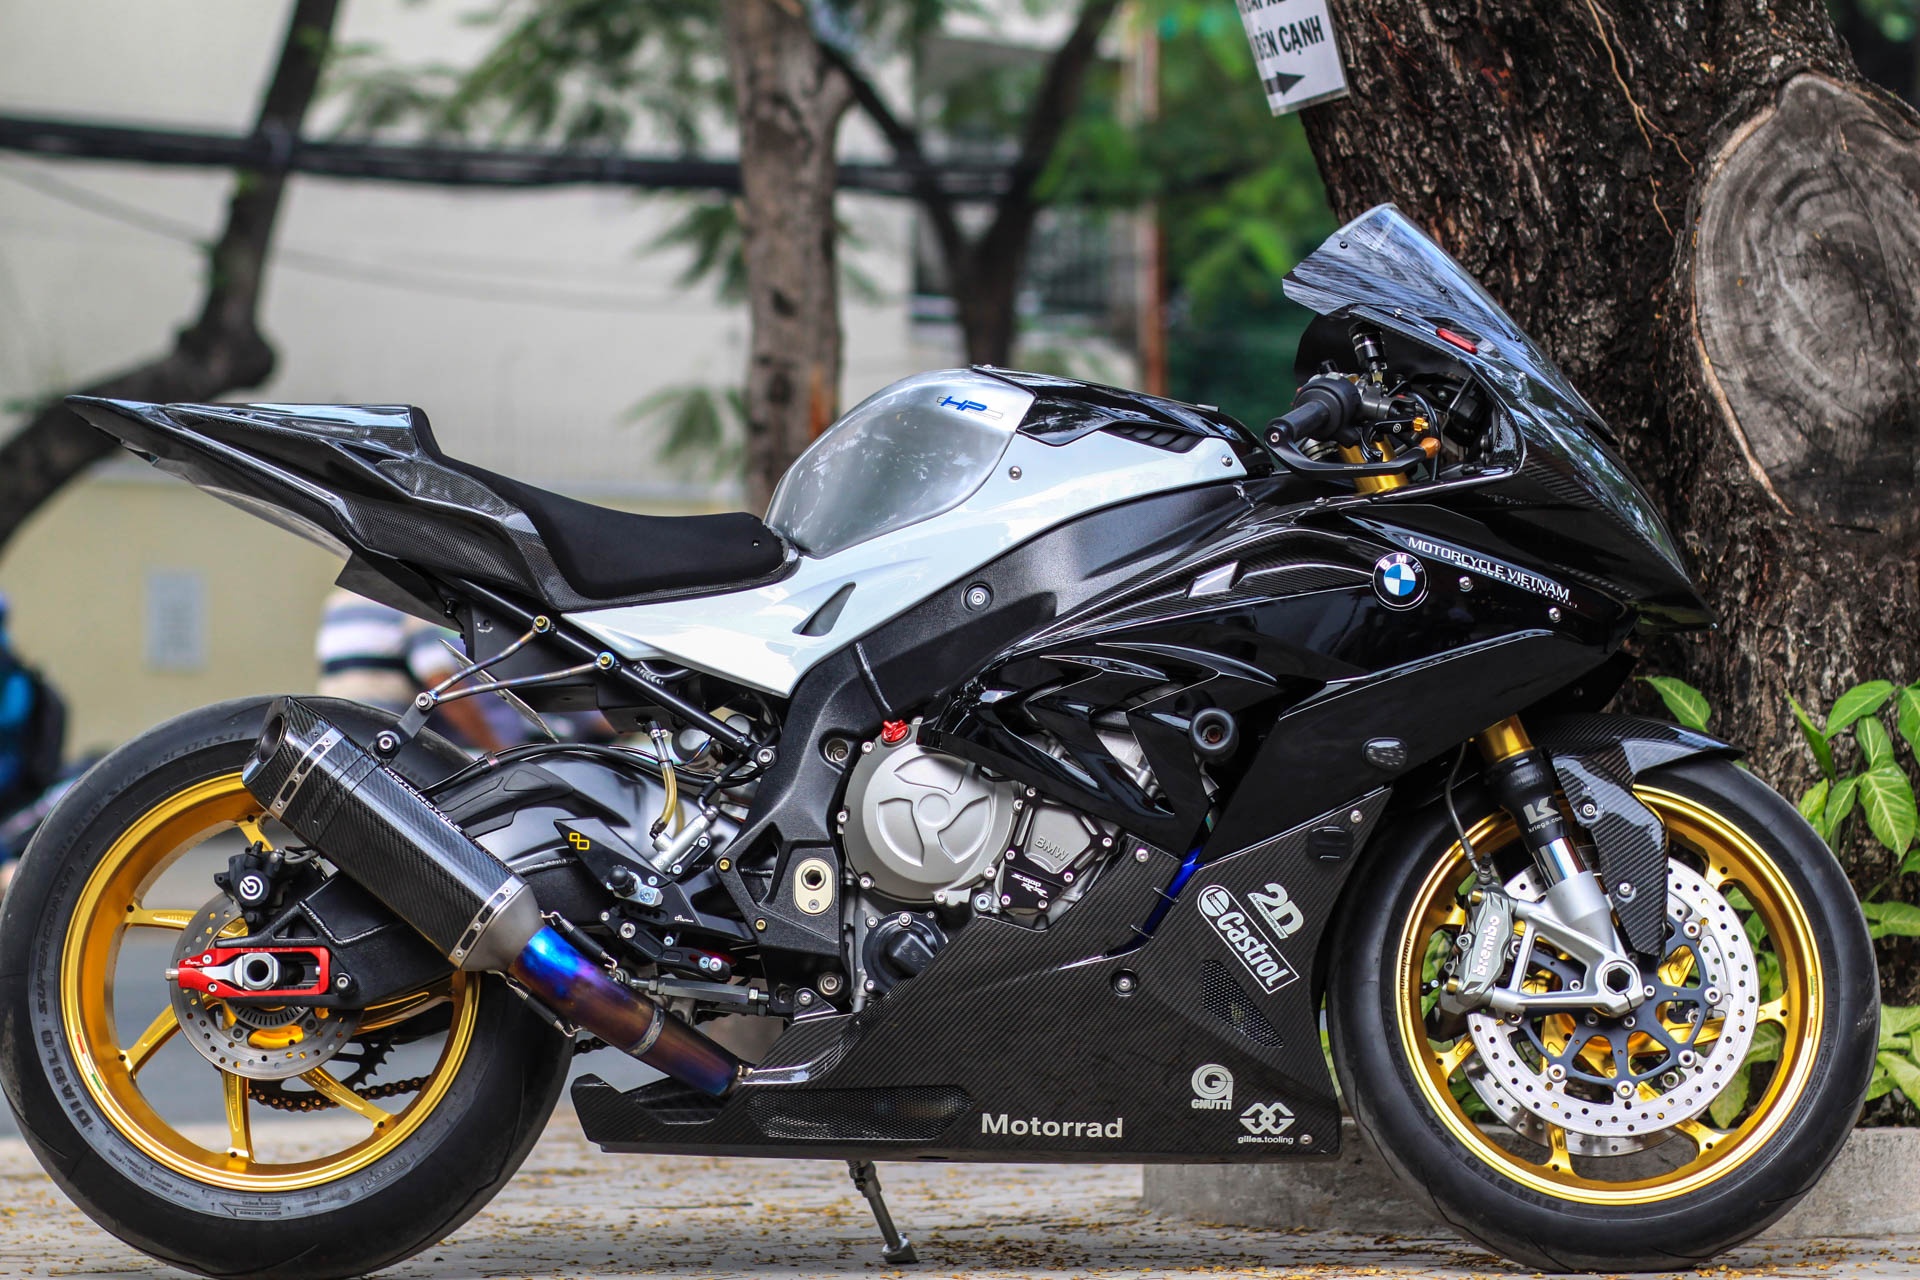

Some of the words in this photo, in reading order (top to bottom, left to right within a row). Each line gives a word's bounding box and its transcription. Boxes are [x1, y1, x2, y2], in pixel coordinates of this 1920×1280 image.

[1278, 15, 1325, 55] CẠNH
[940, 396, 988, 411] HP
[1379, 553, 1422, 574] BMW
[1408, 537, 1504, 576] MOTORCYCLE
[1507, 568, 1571, 601] VIETNAM
[1528, 815, 1564, 834] kriega.com
[1035, 836, 1069, 861] BMW
[1247, 883, 1304, 940] 2D
[1216, 911, 1290, 987] Castrol
[1472, 915, 1501, 978] brembo
[40, 1030, 94, 1129] DIABLO
[1191, 1098, 1232, 1110] GNUTTI
[981, 1113, 1123, 1138] Motorrad
[1237, 1135, 1294, 1145] gilles.tooling
